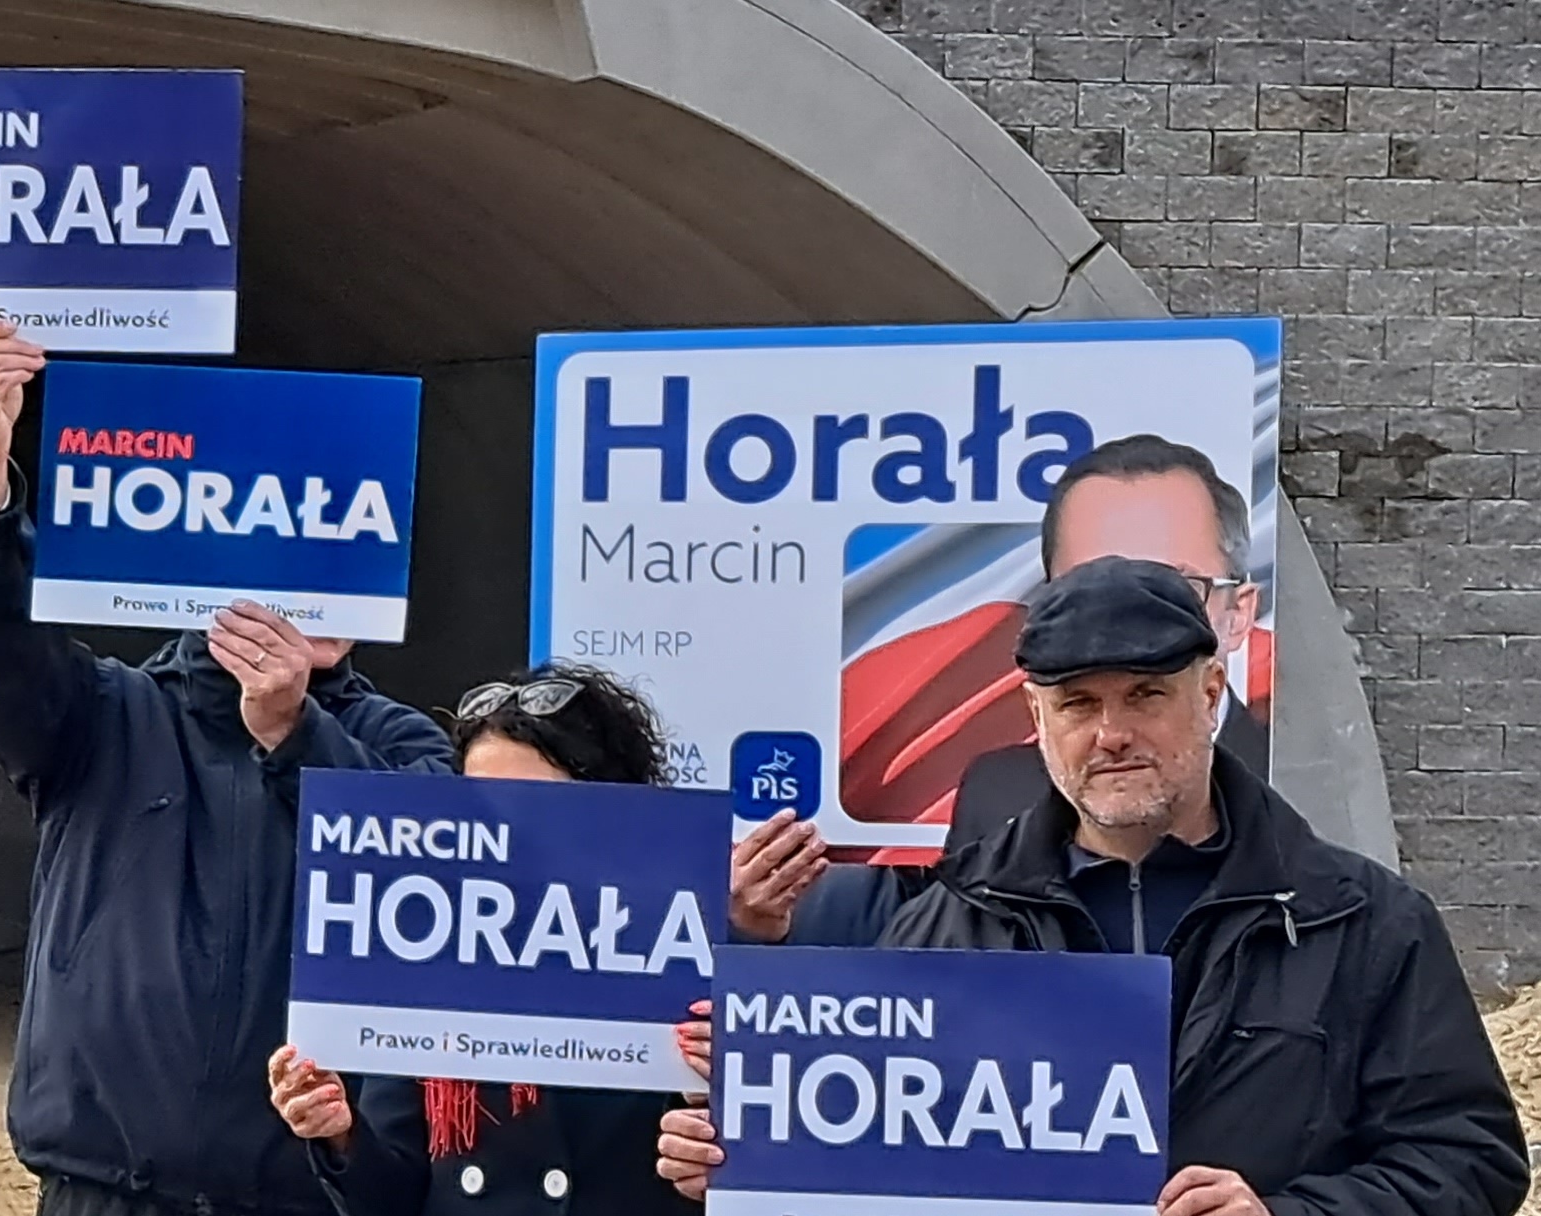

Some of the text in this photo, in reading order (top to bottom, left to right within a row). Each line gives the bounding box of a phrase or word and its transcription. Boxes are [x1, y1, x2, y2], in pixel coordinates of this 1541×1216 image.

[57, 427, 194, 460] MARCIN
[582, 364, 1095, 504] Horała
[52, 464, 399, 544] HORAŁA
[580, 523, 807, 585] Marcin
[112, 595, 168, 613] Prawo
[572, 629, 693, 657] SEJM RP
[310, 812, 510, 863] MARCIN
[305, 869, 713, 977] HORAŁA
[724, 994, 934, 1038] MARCIN
[358, 1027, 651, 1065] Prawo i Sprawiedliwość
[722, 1051, 1159, 1155] HORAŁA
